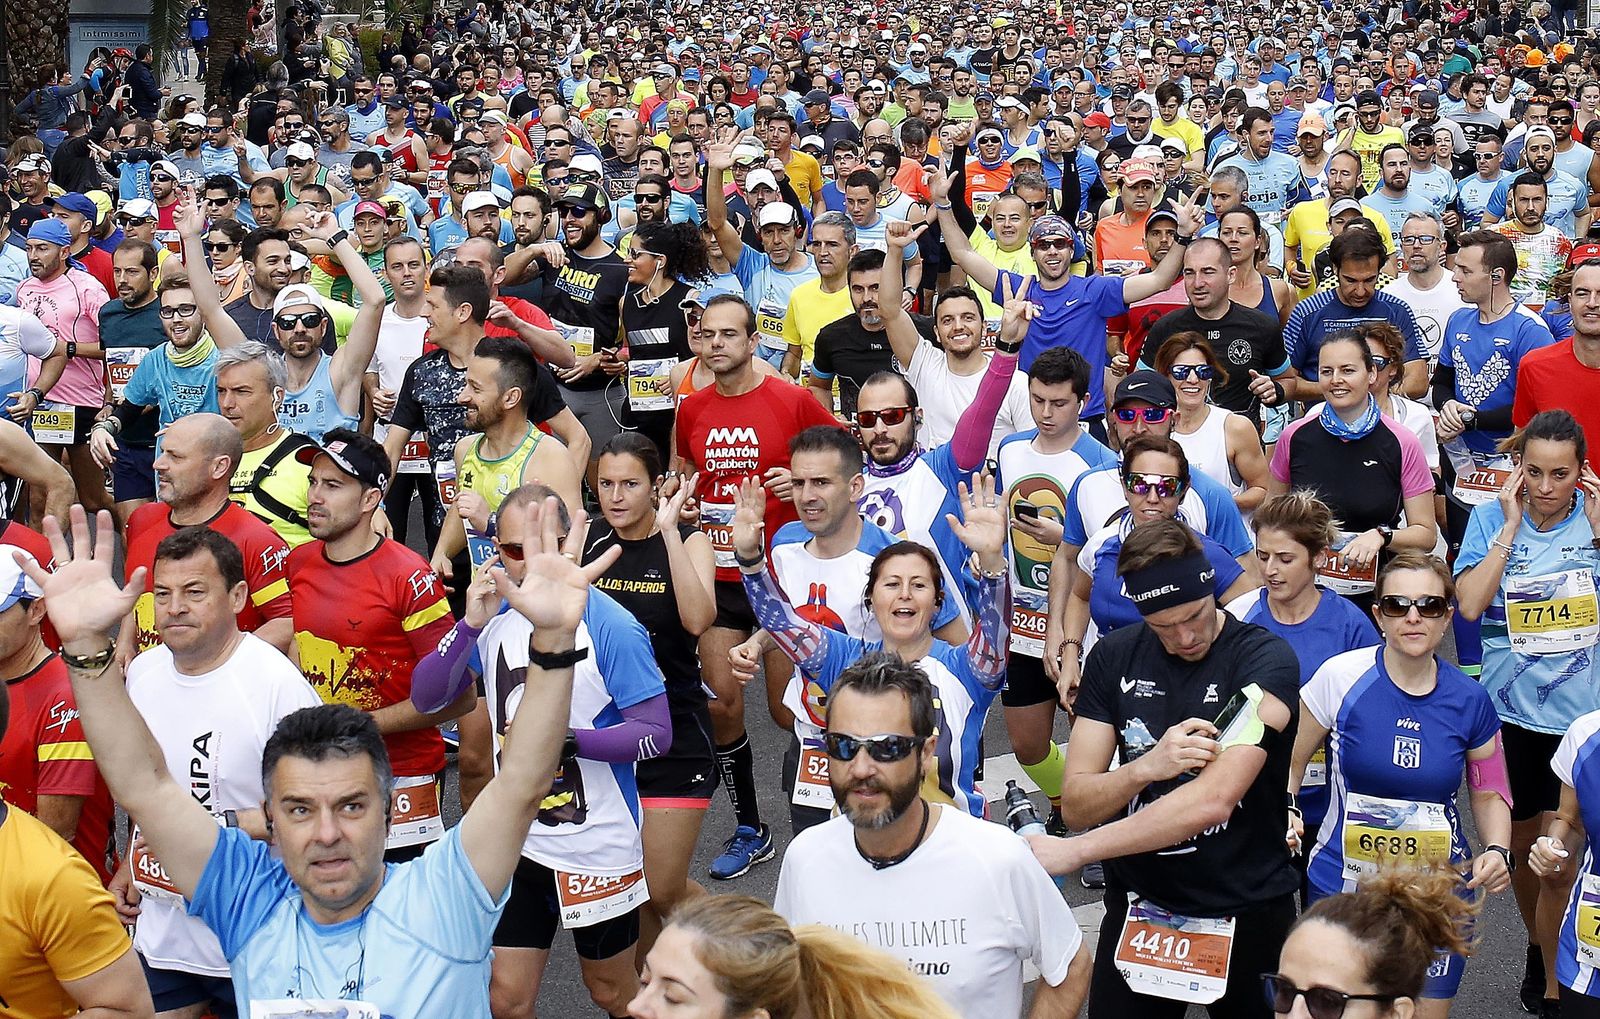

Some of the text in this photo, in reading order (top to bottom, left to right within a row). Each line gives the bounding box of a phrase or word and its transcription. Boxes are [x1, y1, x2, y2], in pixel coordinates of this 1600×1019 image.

[1247, 190, 1279, 204] erja
[558, 264, 600, 290] PURO
[762, 318, 783, 332] 656
[635, 380, 660, 392] 794
[32, 414, 59, 425] 7849
[705, 445, 759, 459] MARATÓN
[622, 581, 667, 593] TAPEROS
[1519, 603, 1571, 624] 7714
[1012, 611, 1047, 633] 5246
[1396, 717, 1421, 731] vive
[797, 788, 811, 798] edp
[1359, 833, 1417, 856] 6688
[1347, 863, 1362, 874] edp
[565, 909, 581, 920] edp
[875, 920, 895, 948] TU
[901, 917, 968, 948] LIMITE
[1129, 929, 1192, 960] 4410
